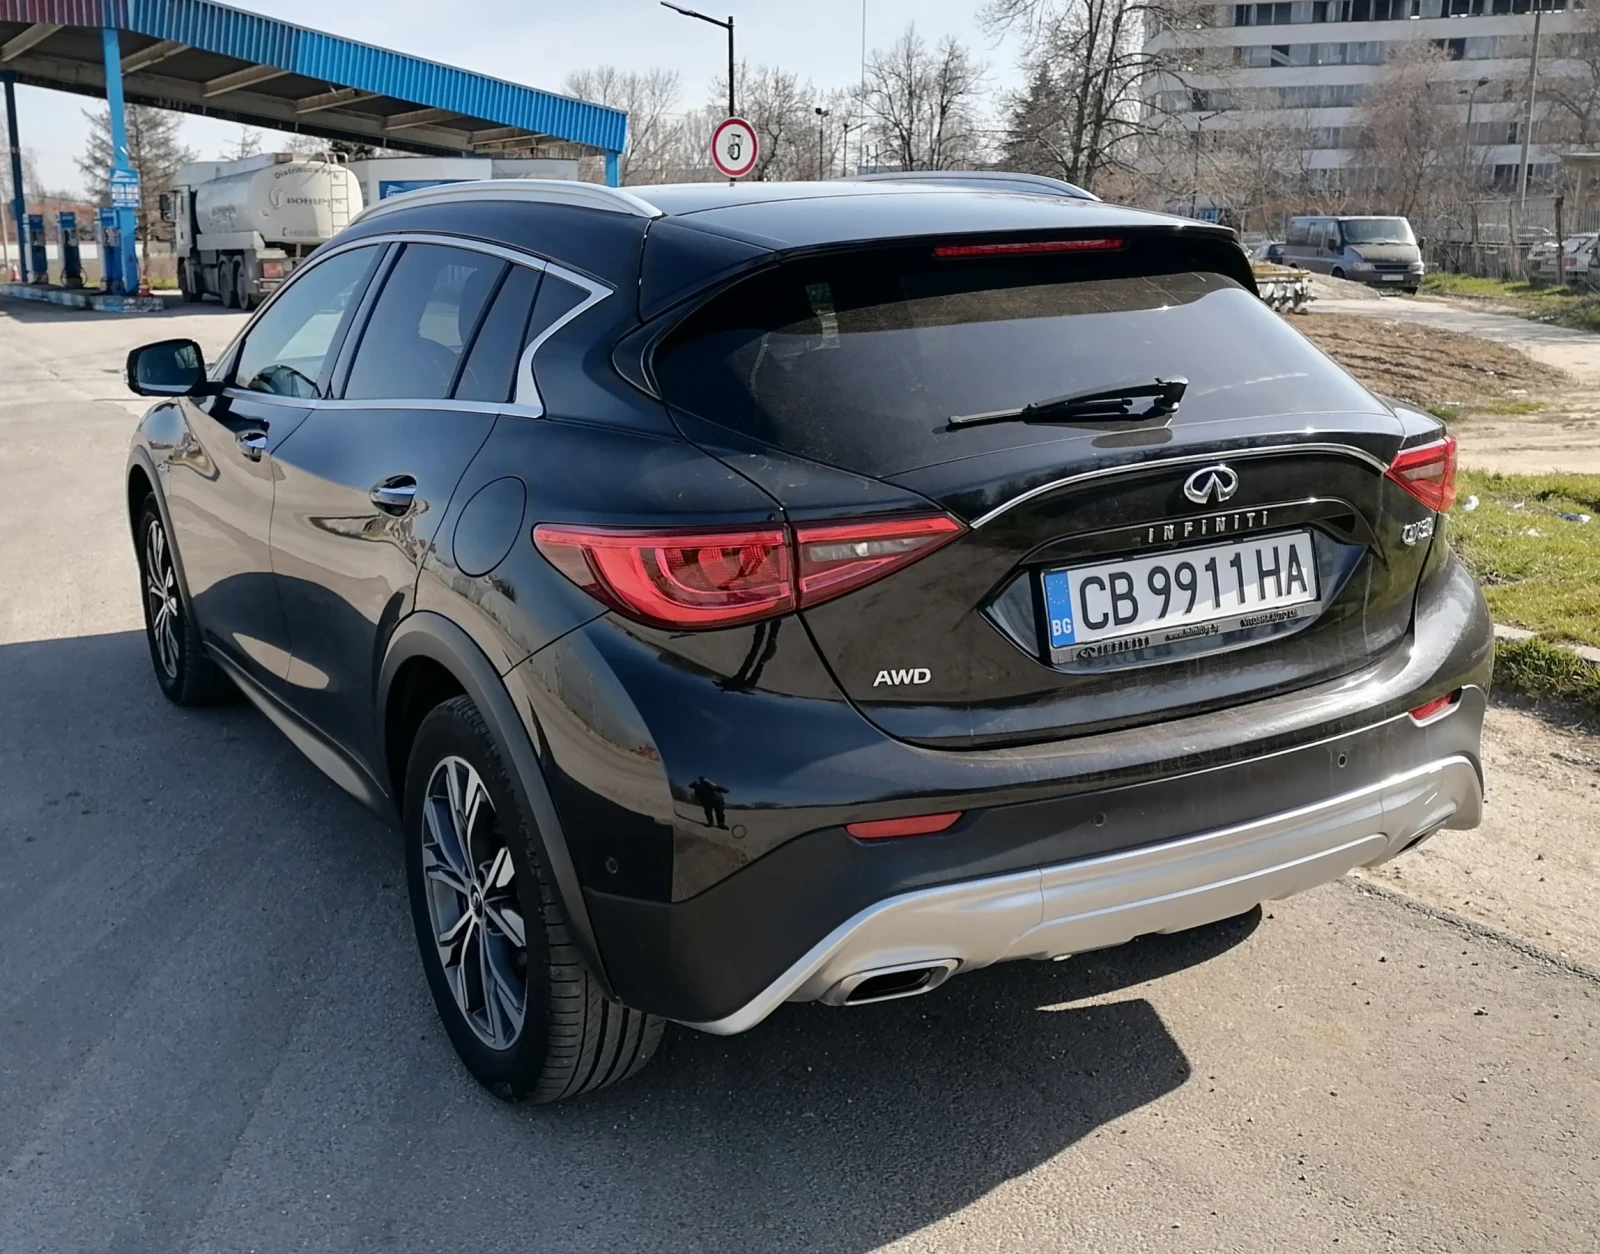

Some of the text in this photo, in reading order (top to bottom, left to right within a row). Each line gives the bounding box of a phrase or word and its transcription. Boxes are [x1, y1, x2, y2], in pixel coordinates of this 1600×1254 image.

[1148, 510, 1268, 543] INFINITI
[1078, 544, 1308, 631] CB 9911 HA
[1051, 617, 1073, 637] BG
[872, 667, 932, 687] AWD
